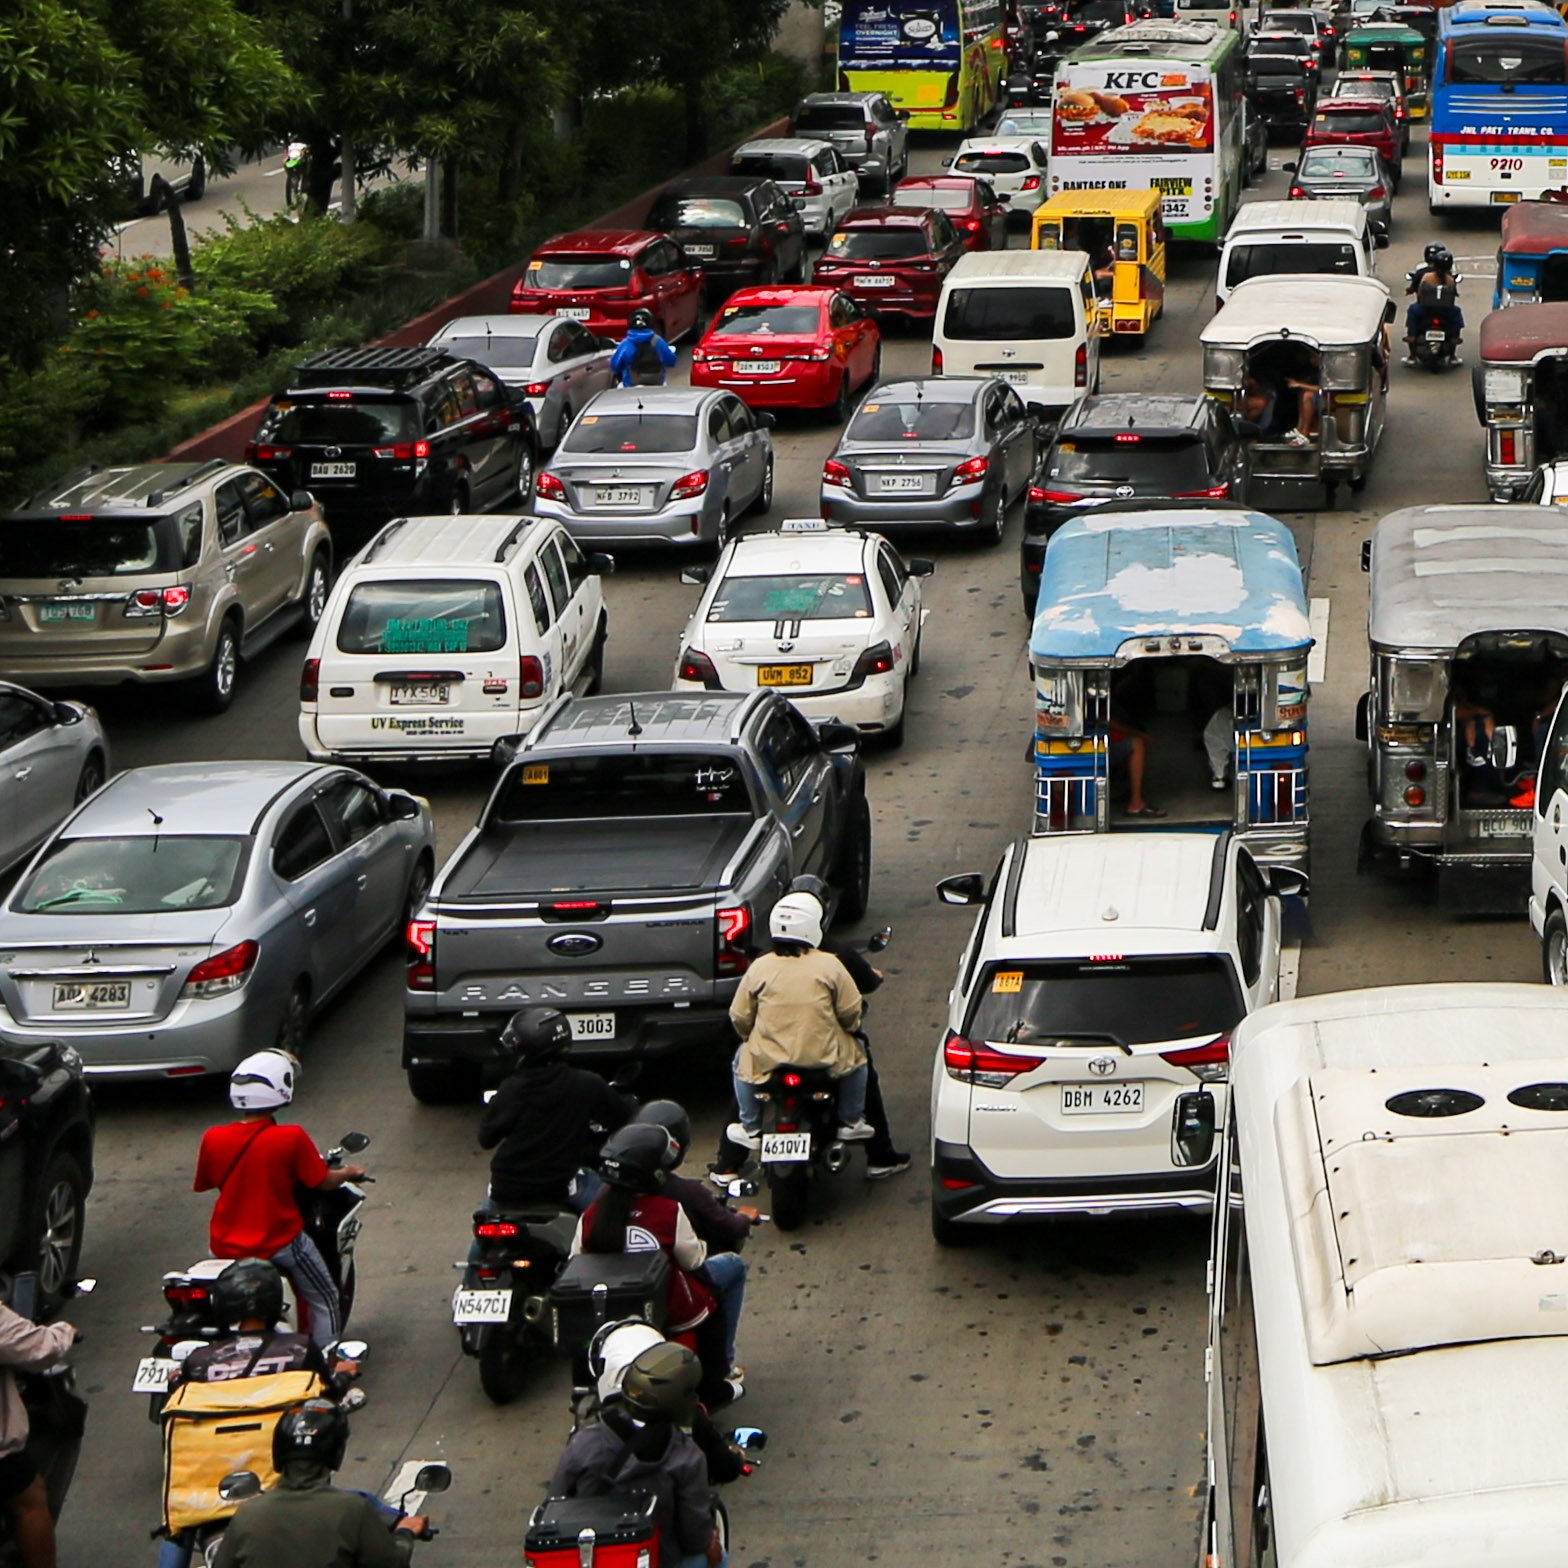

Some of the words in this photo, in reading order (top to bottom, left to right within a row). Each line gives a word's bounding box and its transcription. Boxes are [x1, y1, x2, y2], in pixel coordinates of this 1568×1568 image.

[1104, 72, 1158, 89] KFC
[1490, 158, 1523, 171] 9210
[1150, 177, 1193, 188] FAIRVIEW
[372, 718, 386, 729] UV
[388, 717, 427, 731] Express
[428, 717, 464, 729] Service
[92, 987, 127, 1003] 4283
[460, 978, 691, 1002] RANGER
[577, 1018, 614, 1034] 3003
[1064, 1091, 1092, 1108] DBM
[1103, 1089, 1141, 1106] 4262
